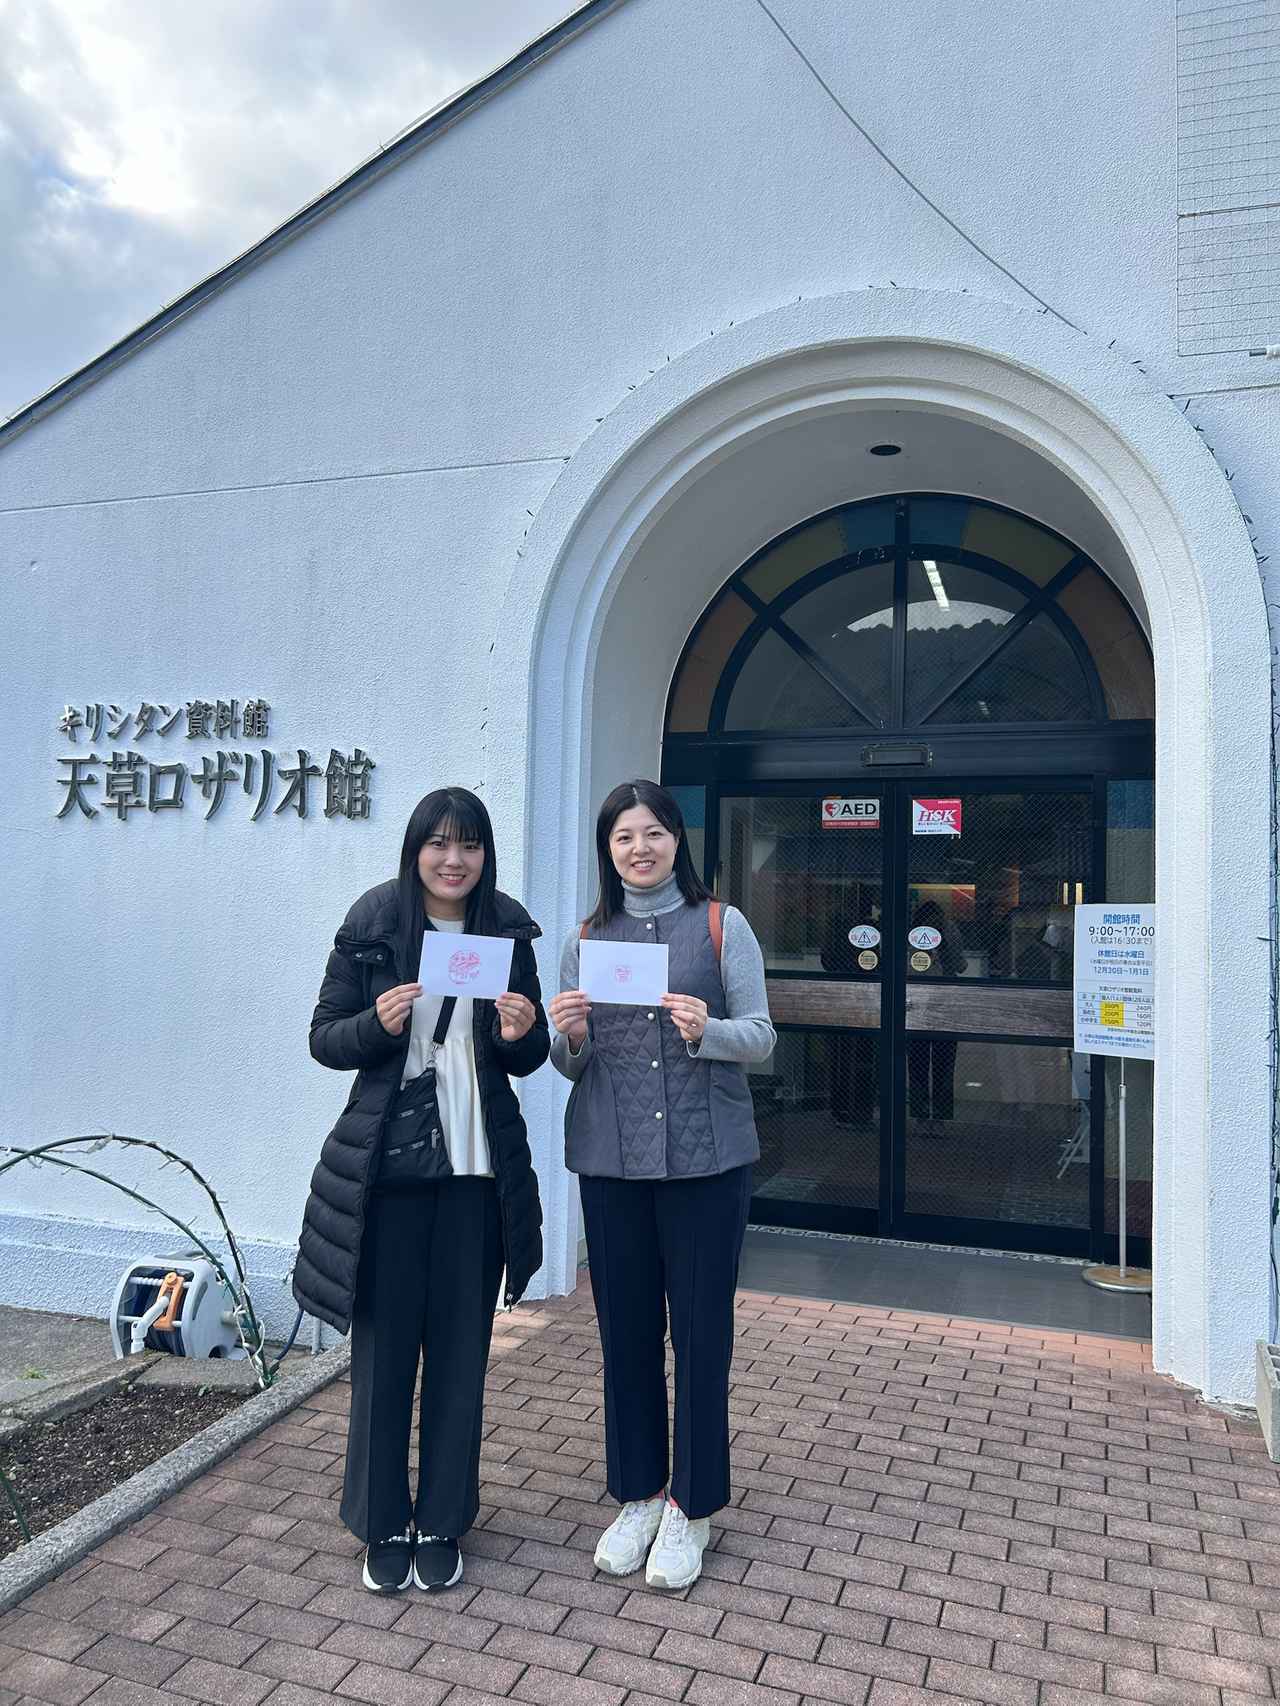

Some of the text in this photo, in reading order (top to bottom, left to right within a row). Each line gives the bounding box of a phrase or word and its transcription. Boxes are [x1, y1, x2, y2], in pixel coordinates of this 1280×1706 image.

[57, 699, 271, 742] キリシタン資料館
[55, 748, 376, 821] 天草ロザリオ館
[841, 803, 877, 815] AED
[1103, 914, 1141, 924] 開館時間
[1088, 926, 1155, 937] 9:00～17:00
[1097, 949, 1145, 958] 休館日は水曜日
